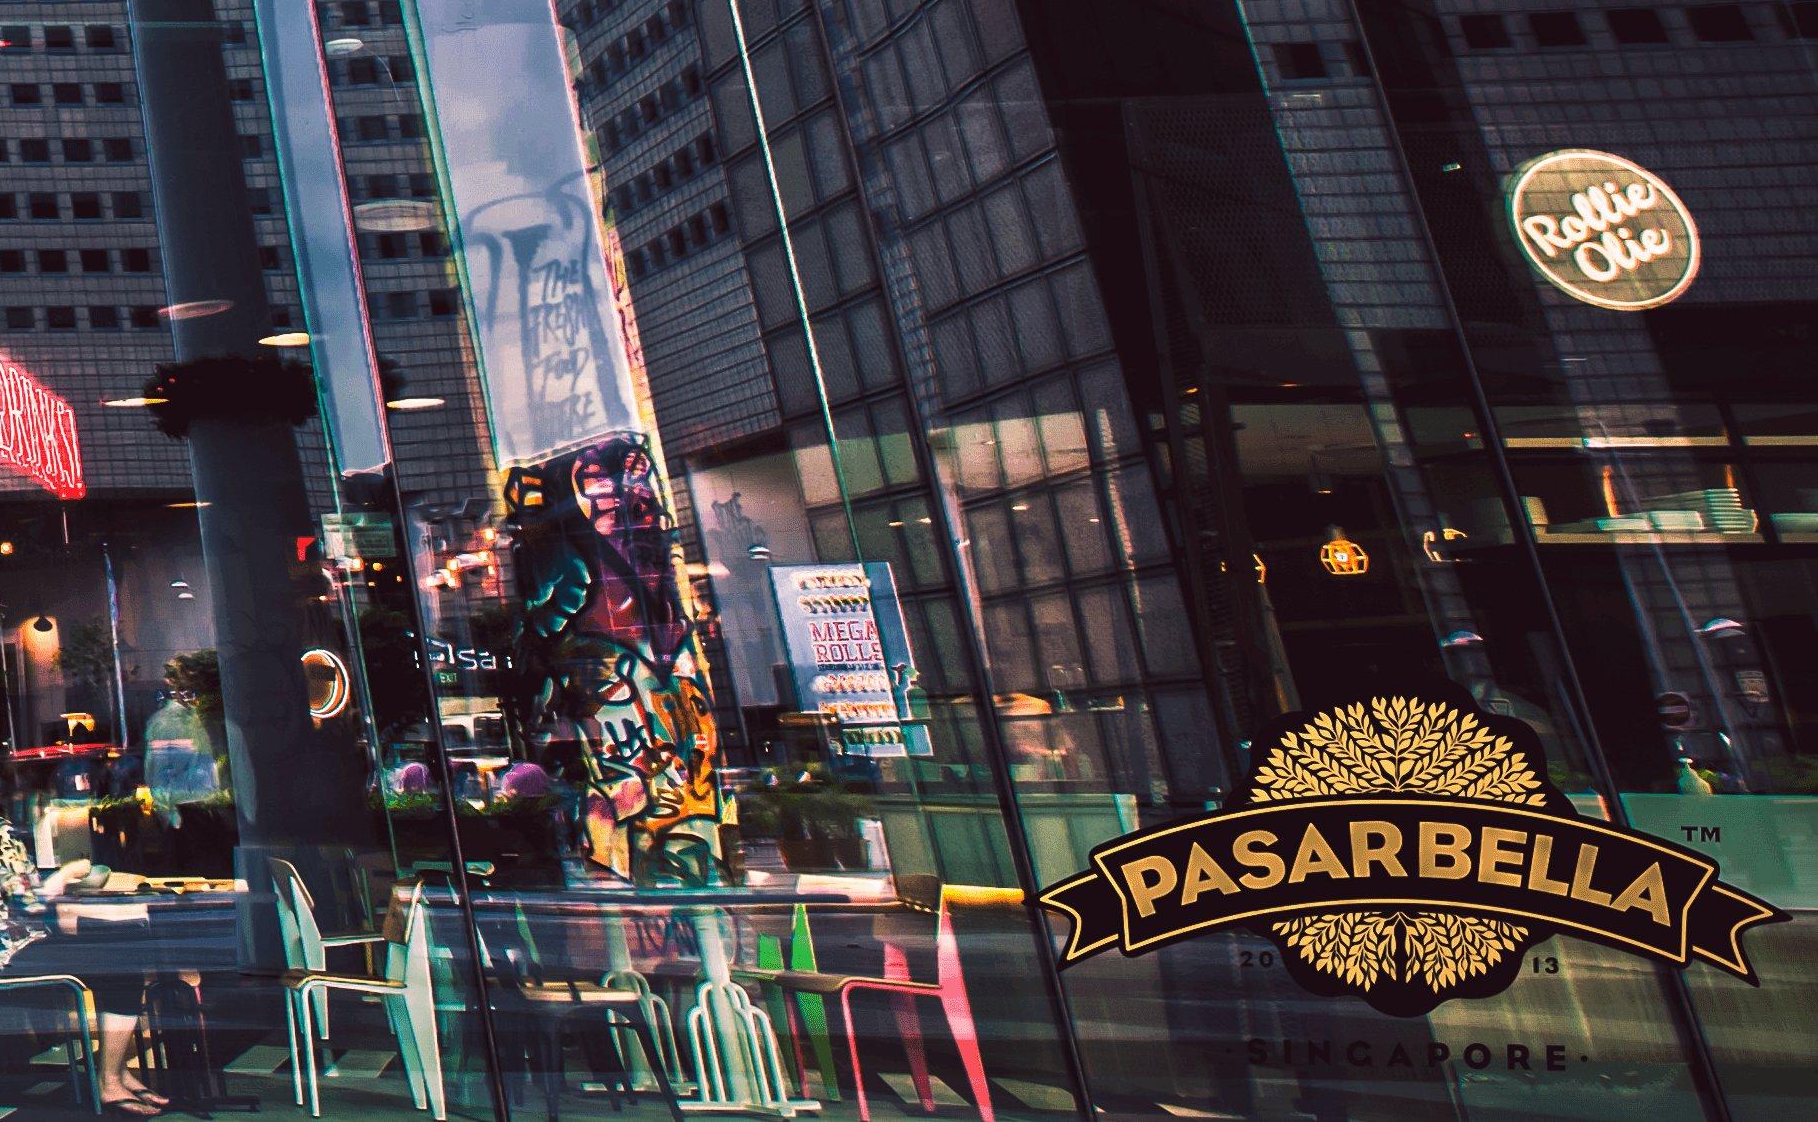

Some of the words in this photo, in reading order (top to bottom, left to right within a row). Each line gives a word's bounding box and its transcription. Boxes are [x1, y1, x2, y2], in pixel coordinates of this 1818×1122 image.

[1523, 181, 1660, 258] Rollie
[1574, 227, 1673, 282] Olie
[809, 619, 879, 642] MEGA
[439, 672, 457, 683] EXIT
